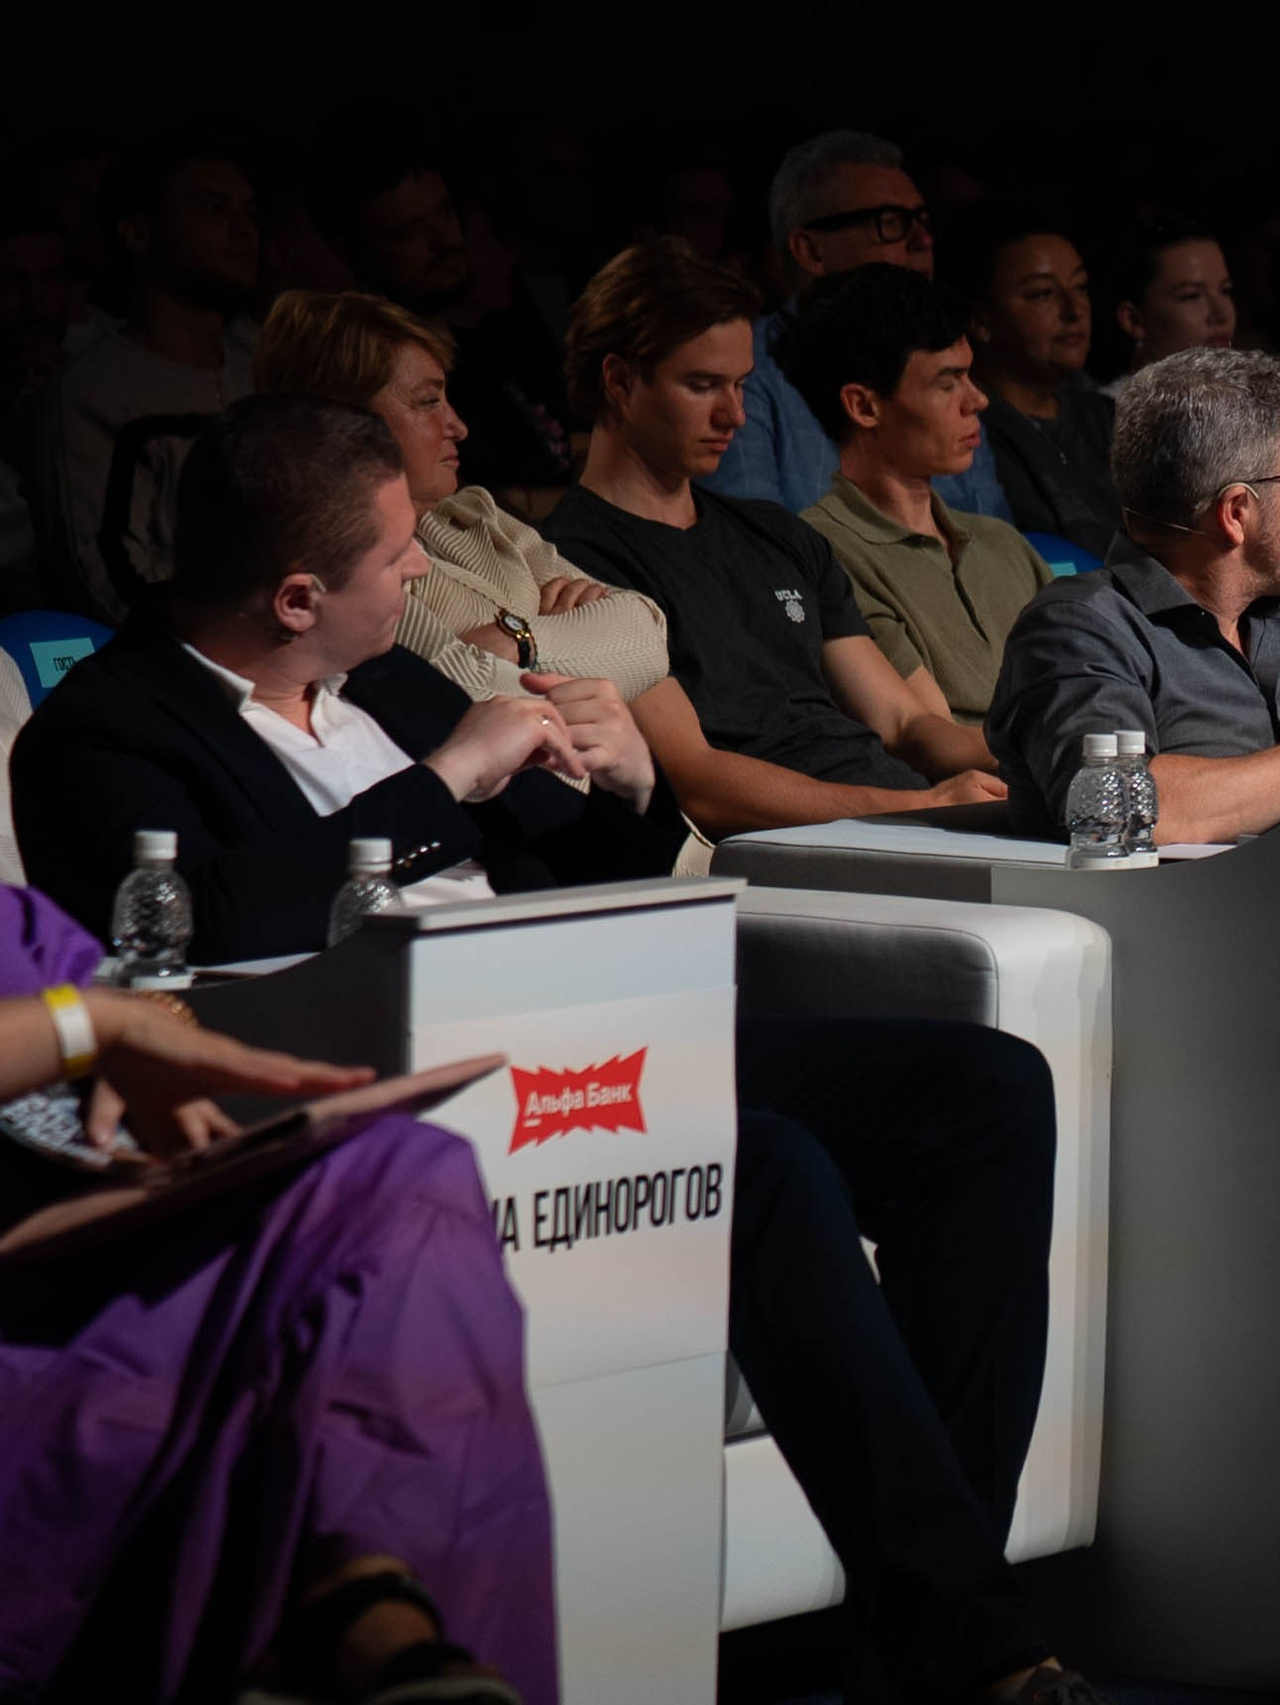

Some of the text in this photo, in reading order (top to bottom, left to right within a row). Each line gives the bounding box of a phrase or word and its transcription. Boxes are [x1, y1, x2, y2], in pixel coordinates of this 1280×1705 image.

[525, 1083, 632, 1118] Альфа Банк
[533, 1162, 722, 1254] ЕДИНОРОГОВ
